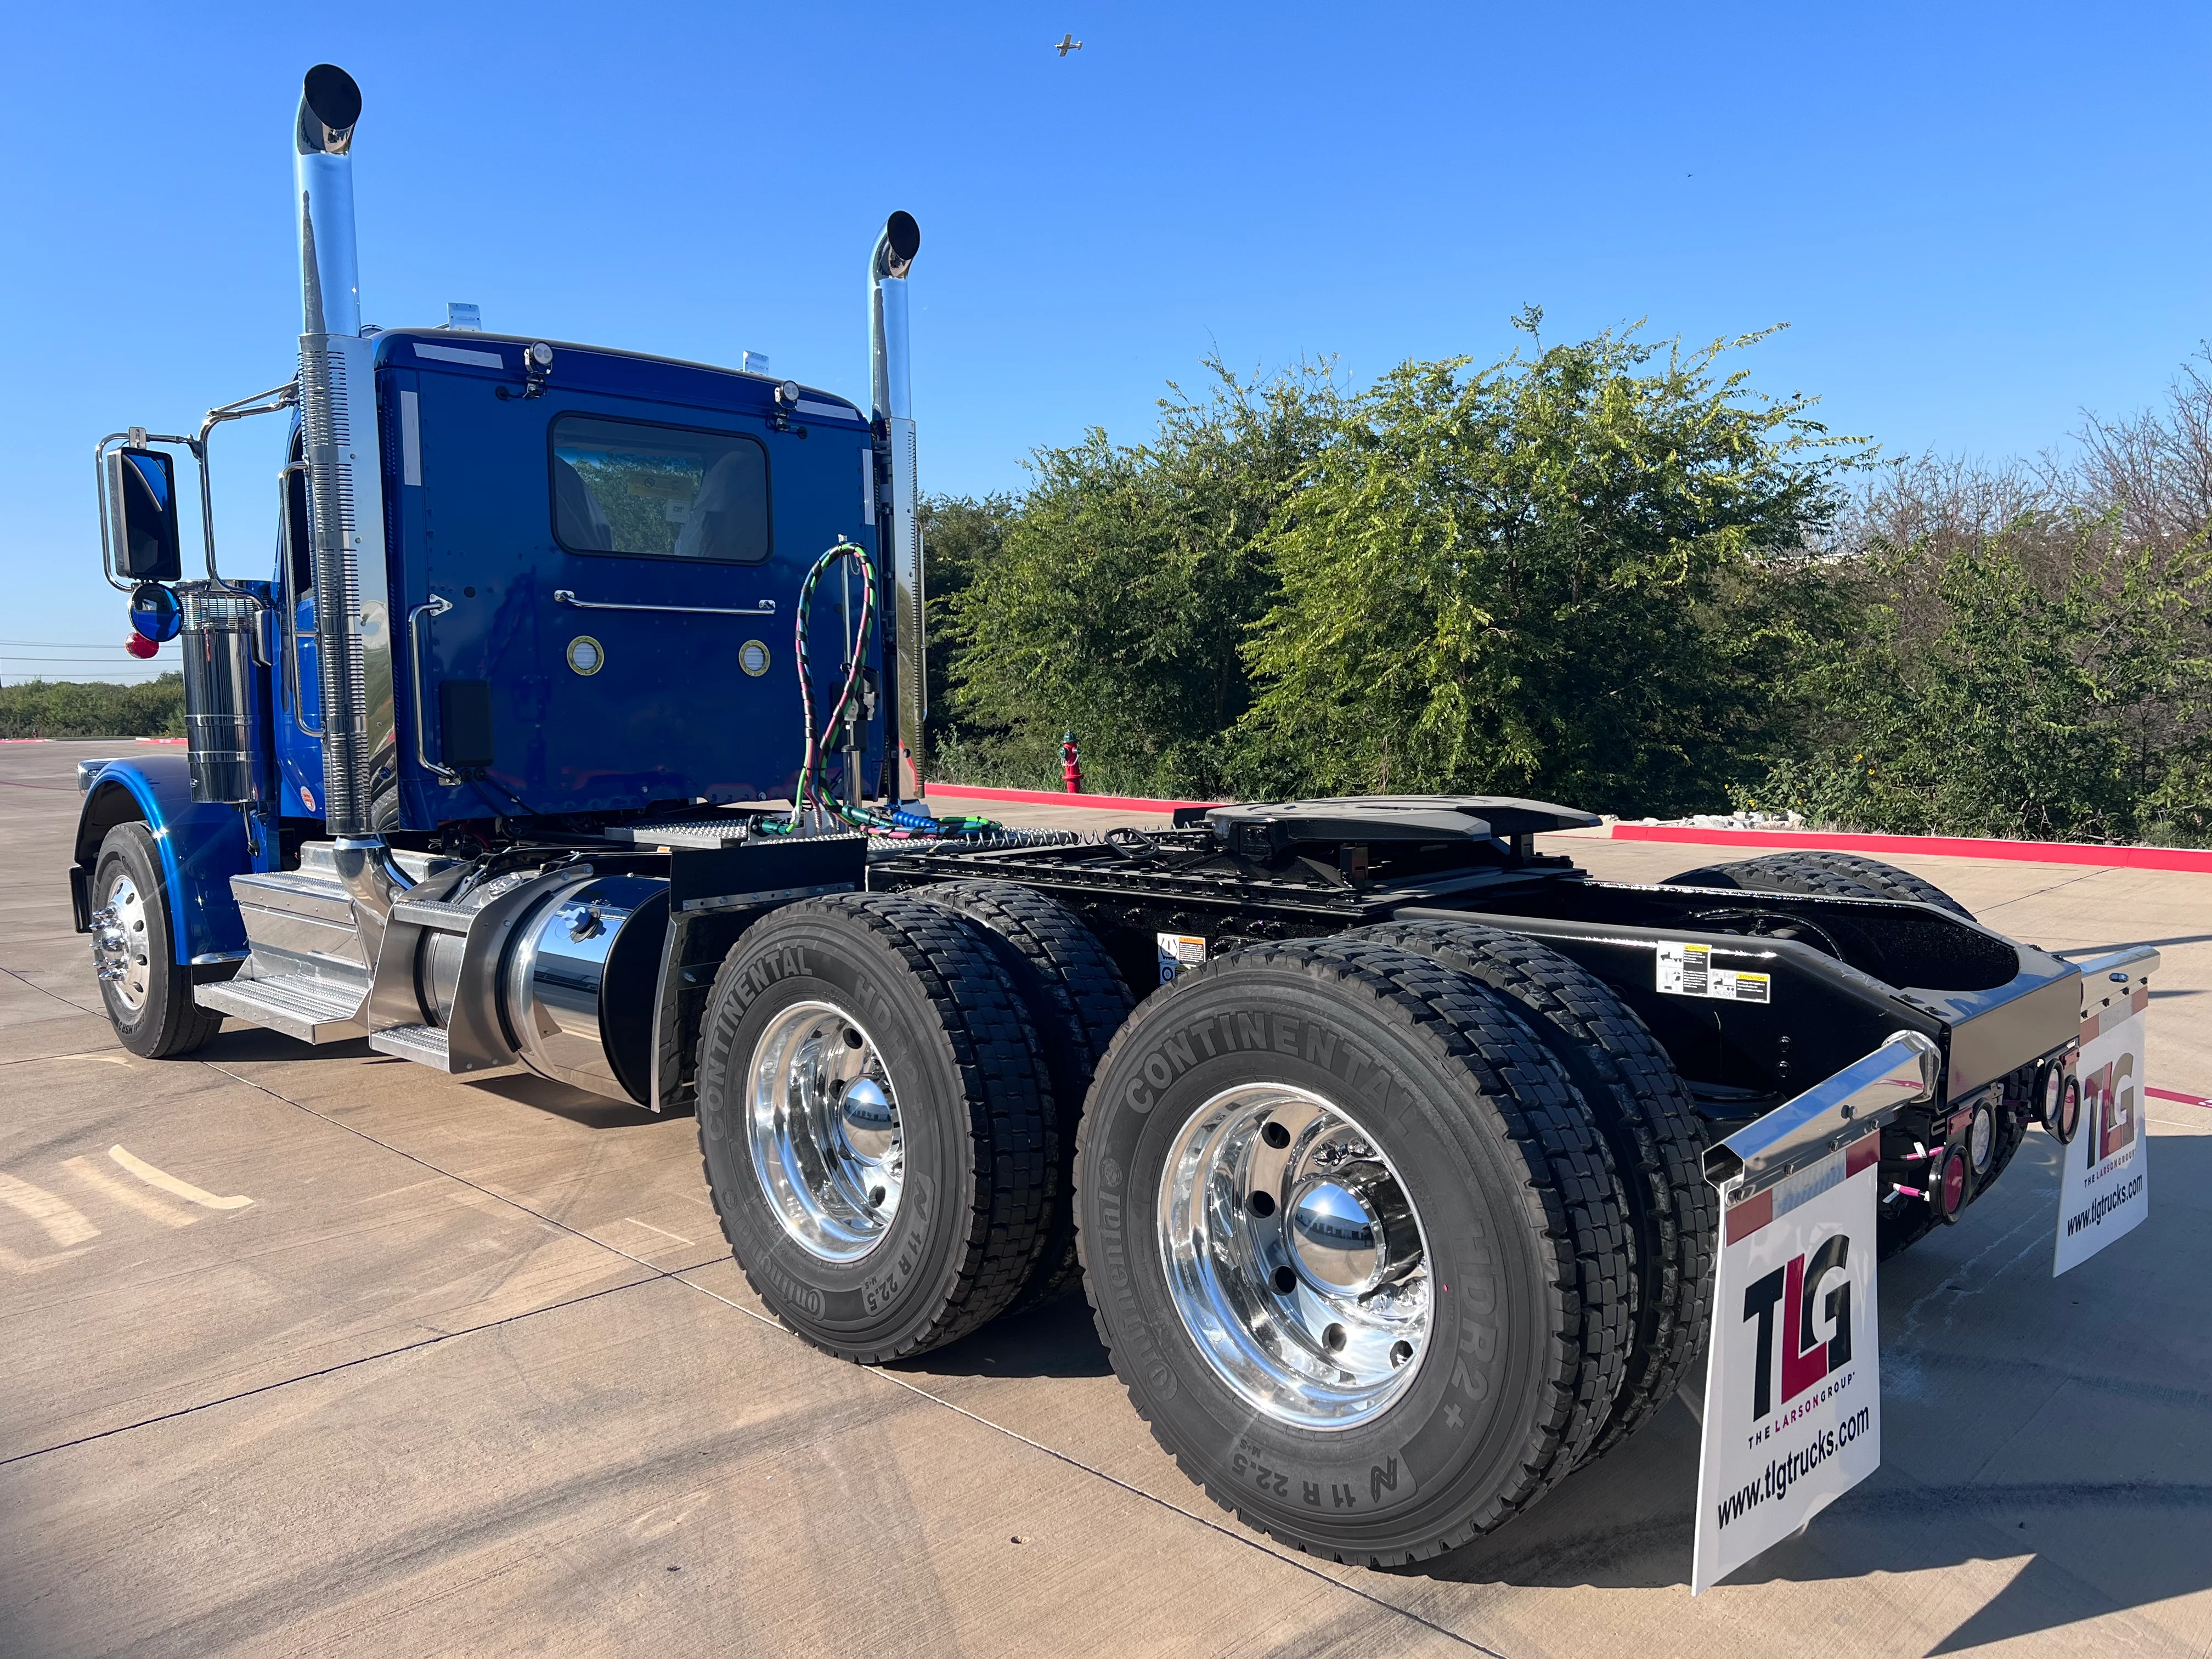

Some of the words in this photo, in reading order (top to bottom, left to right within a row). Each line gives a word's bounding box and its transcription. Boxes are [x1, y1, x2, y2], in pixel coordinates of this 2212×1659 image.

[706, 946, 812, 1141] CONTINENTAL
[1126, 1011, 1414, 1137] CONTINENTAL
[2084, 1053, 2134, 1170] TLG
[2085, 1174, 2095, 1188] THE
[2068, 1174, 2142, 1237] www.tlgtrucks.com
[898, 1254, 912, 1276] R
[908, 1231, 922, 1256] 11
[730, 1215, 826, 1322] Continental
[865, 1276, 878, 1290] M+S
[867, 1272, 898, 1312] 22.5
[1099, 1190, 1178, 1402] Continental
[1443, 1219, 1497, 1429] HDR2+
[1743, 1234, 1852, 1423] TLG
[1239, 1439, 1262, 1459] M+S
[1748, 1425, 1770, 1449] THE
[1232, 1453, 1289, 1497] 22.5
[1718, 1406, 1869, 1530] www.tlgtrucks.com
[1303, 1481, 1321, 1507] R
[1331, 1483, 1357, 1508] 11
